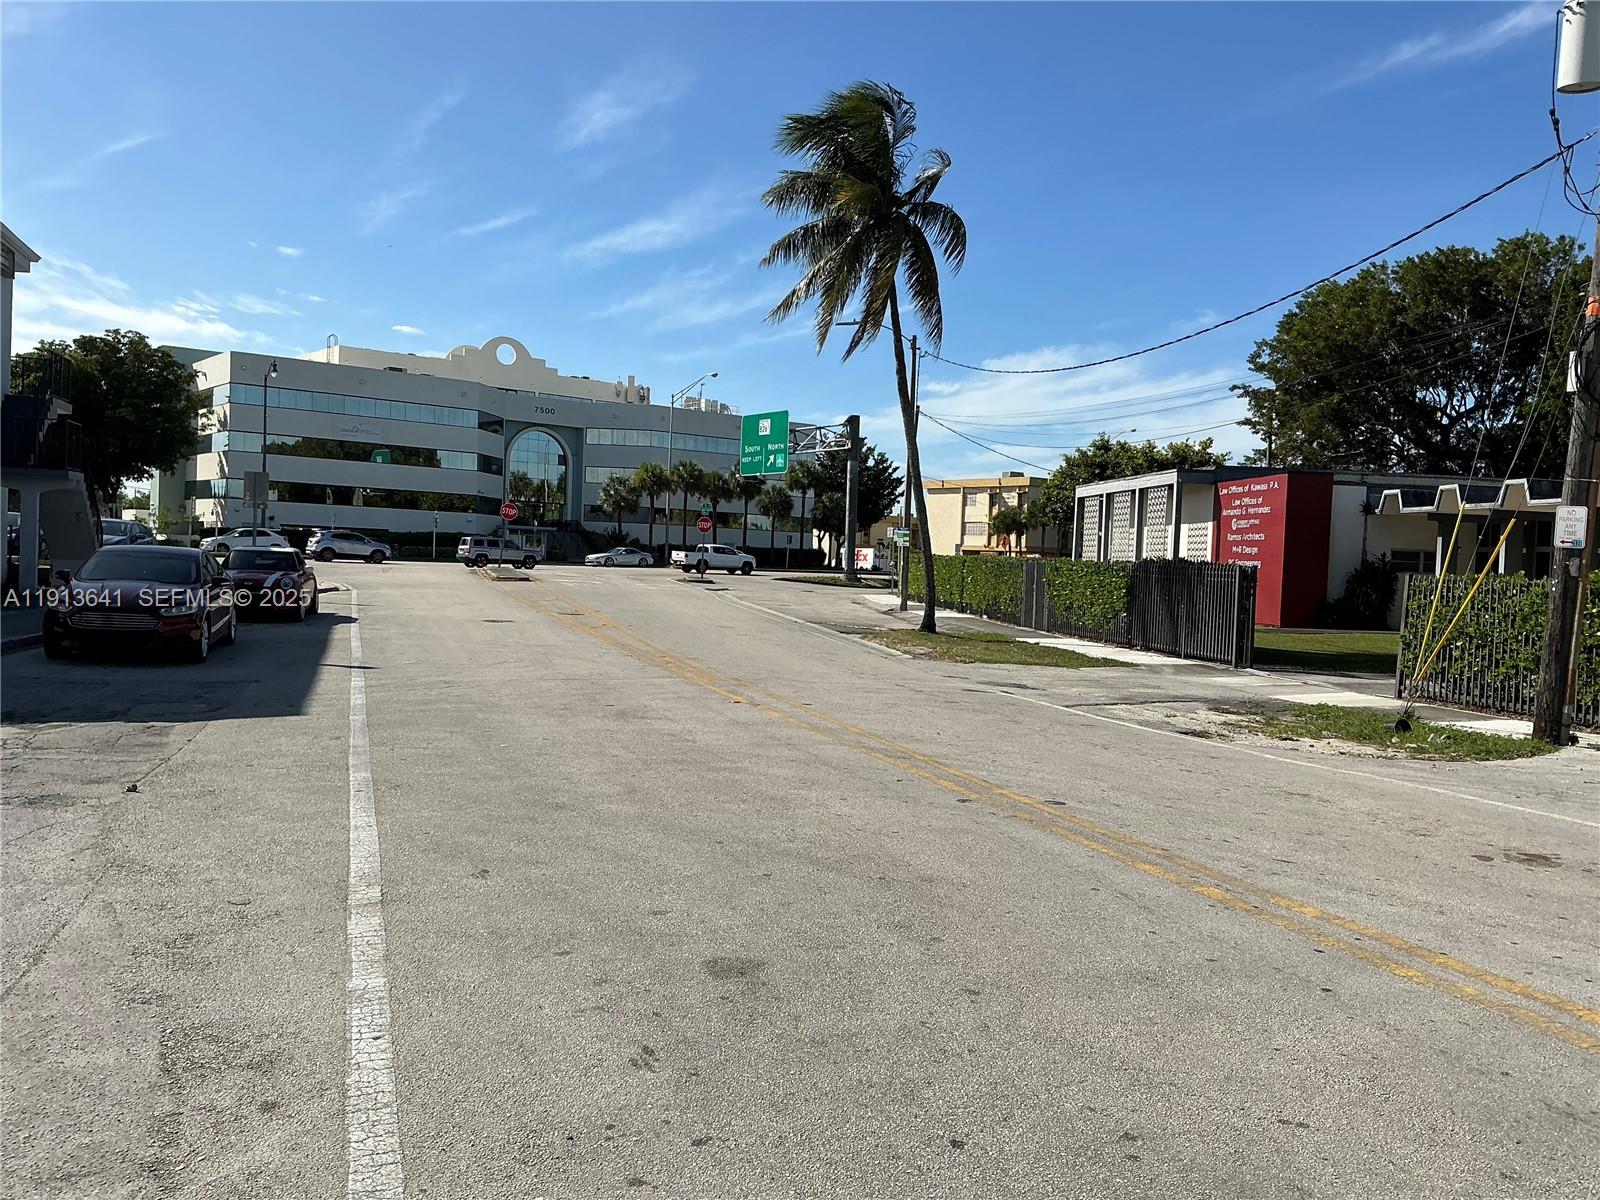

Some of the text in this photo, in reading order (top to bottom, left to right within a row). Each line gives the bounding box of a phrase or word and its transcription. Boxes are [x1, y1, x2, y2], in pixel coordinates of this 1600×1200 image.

[534, 406, 555, 415] 7500
[768, 443, 784, 451] NORTH
[1219, 487, 1227, 495] Law
[1228, 485, 1243, 494] Offices
[1244, 484, 1250, 492] of
[1251, 483, 1268, 491] Kawass
[1232, 496, 1263, 506] Law Offices of
[502, 507, 516, 516] STOP
[1222, 508, 1241, 516] Armando
[1248, 506, 1271, 515] Hernandez
[1227, 533, 1265, 541] Ramos Architects
[1242, 546, 1258, 555] Design
